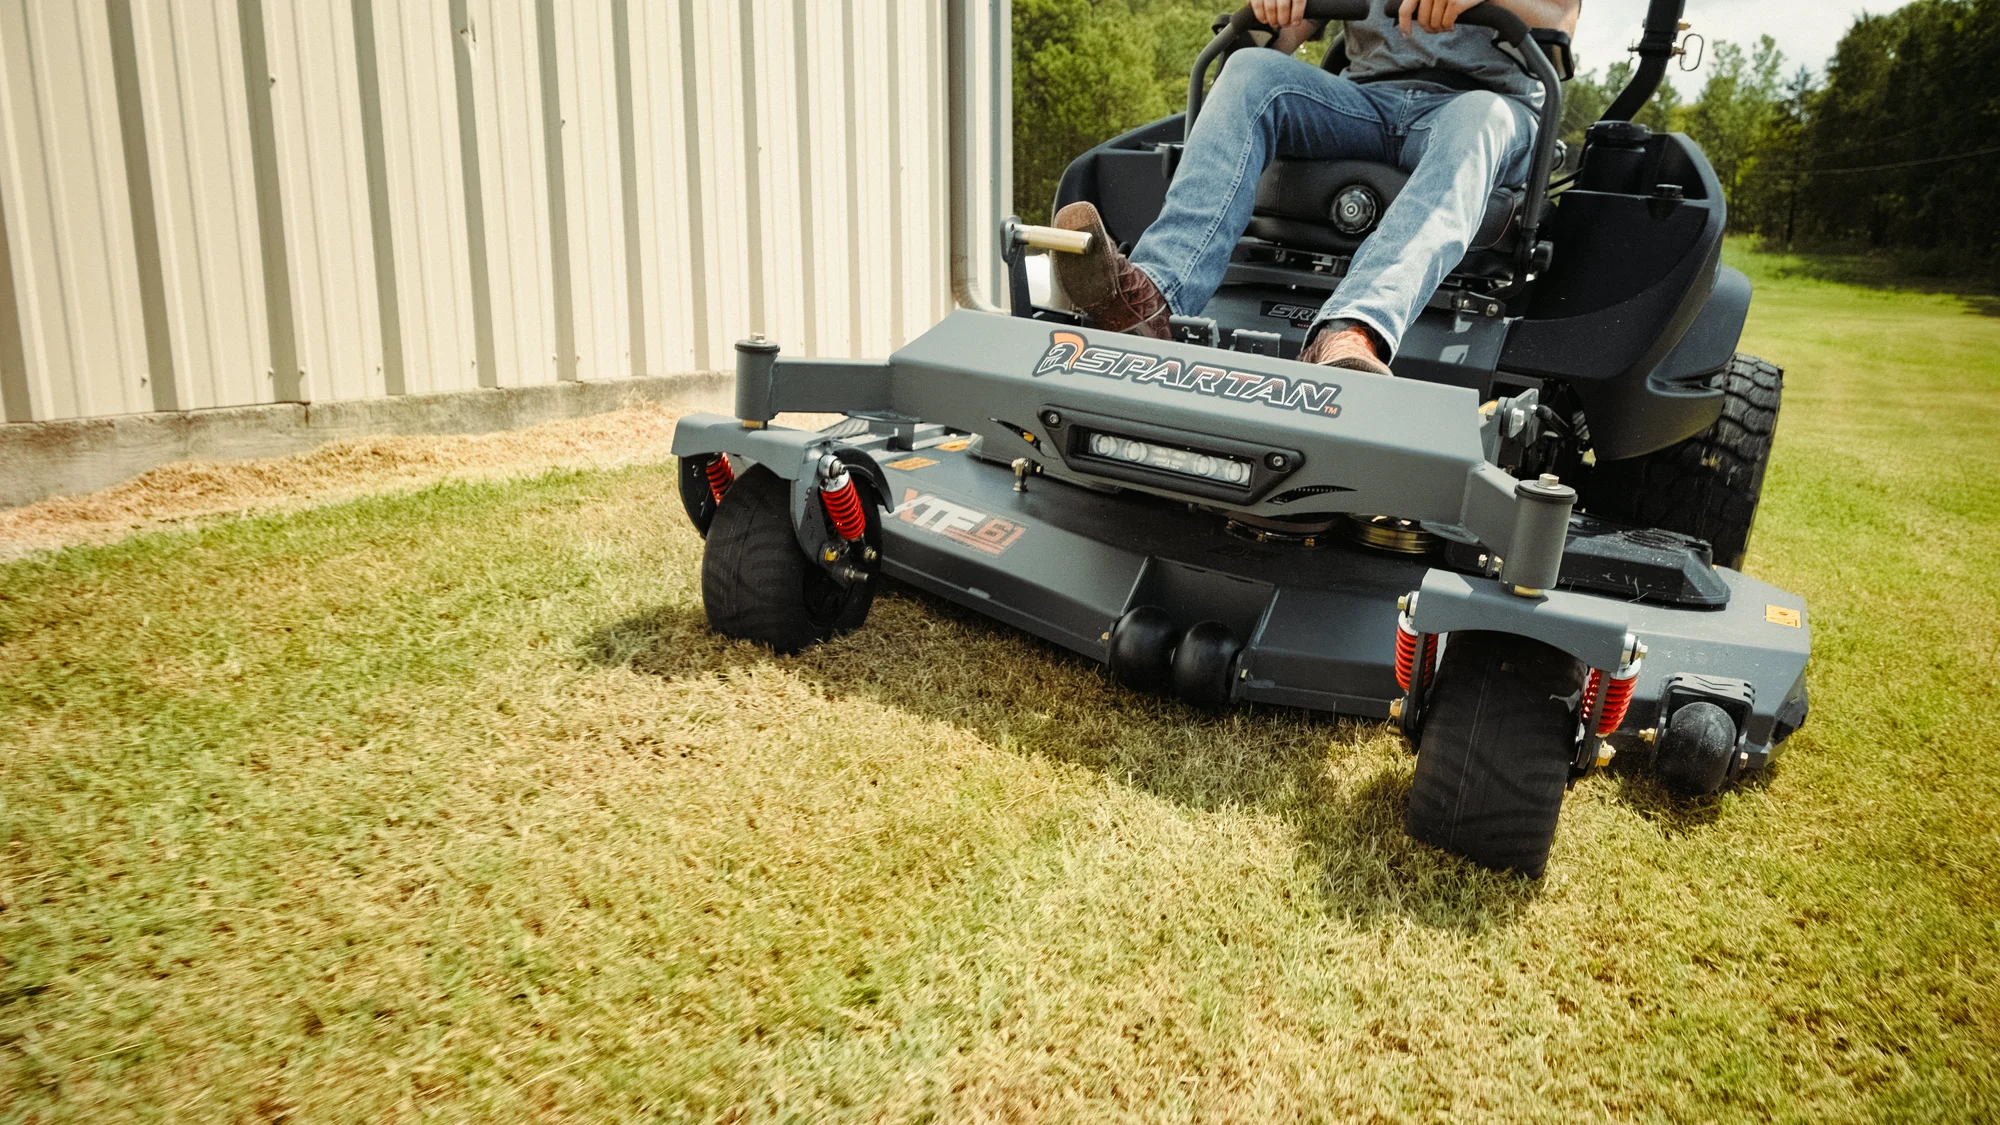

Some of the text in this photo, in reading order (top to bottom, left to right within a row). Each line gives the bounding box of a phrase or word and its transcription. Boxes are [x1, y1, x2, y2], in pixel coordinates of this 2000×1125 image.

[1072, 348, 1337, 411] SPARTAN
[882, 488, 1026, 548] XTF 61
